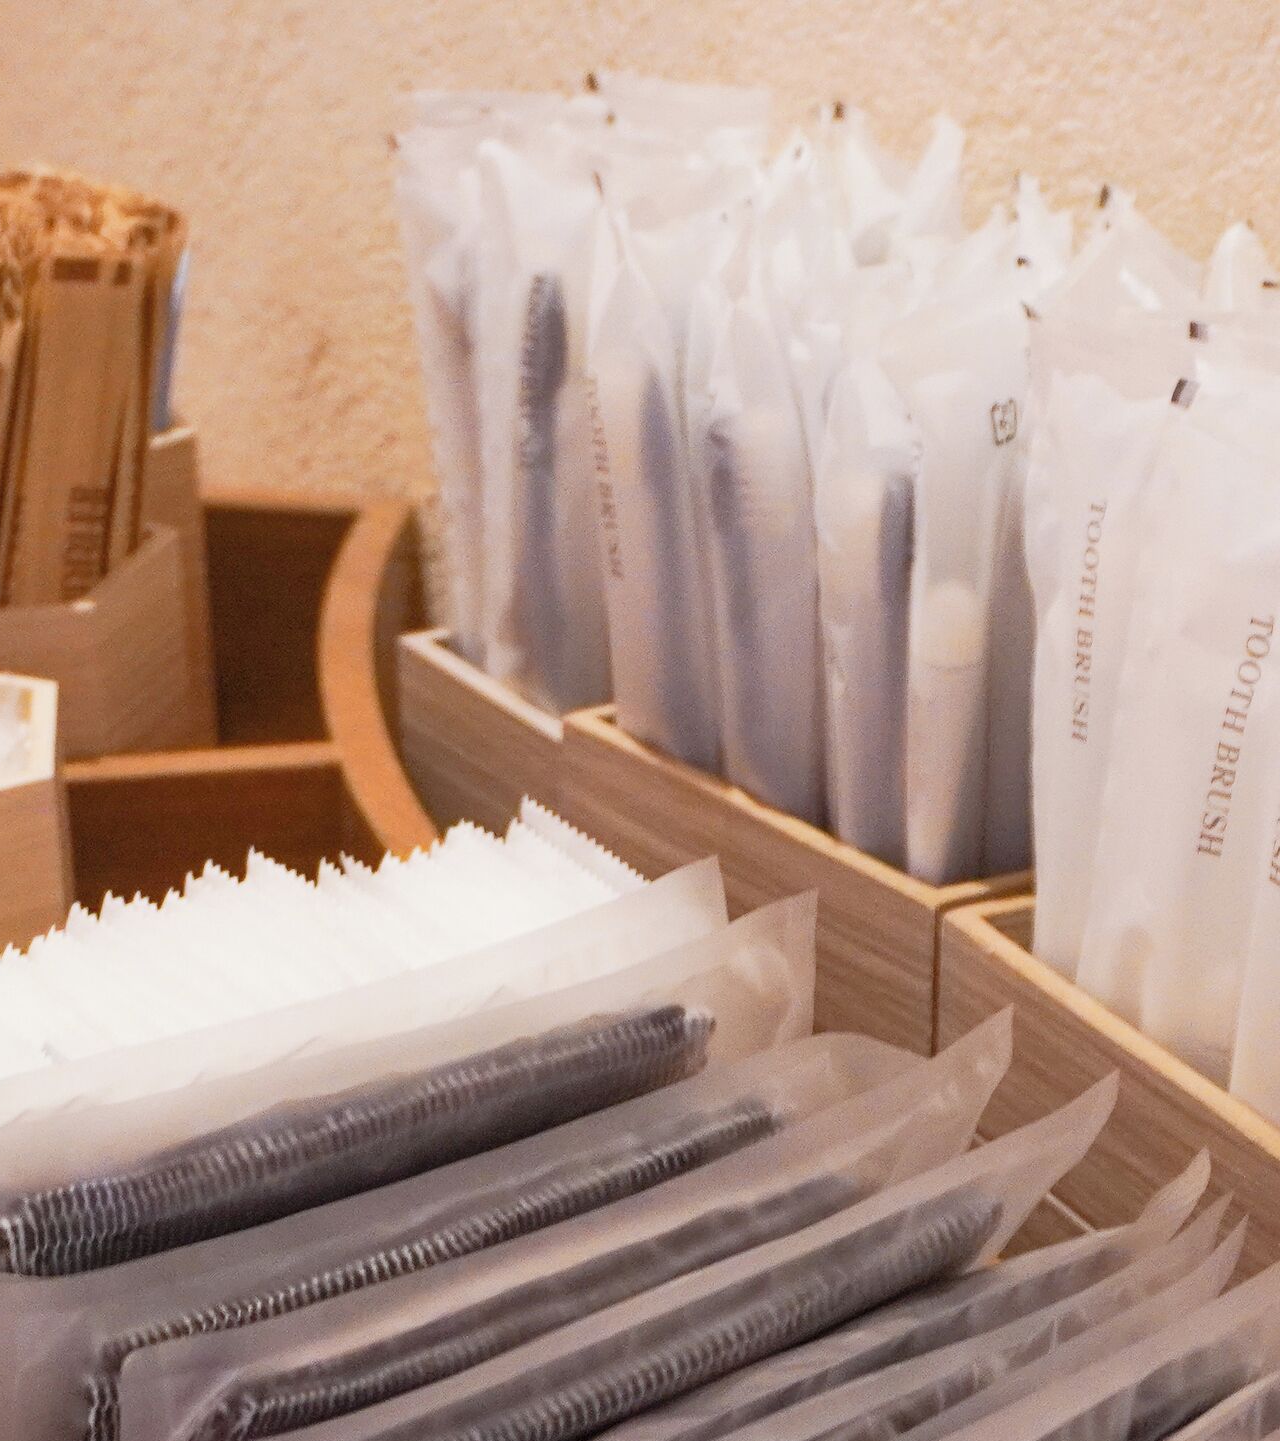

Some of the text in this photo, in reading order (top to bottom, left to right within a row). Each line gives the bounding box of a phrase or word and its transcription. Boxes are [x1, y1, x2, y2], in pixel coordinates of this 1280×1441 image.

[1071, 500, 1108, 742] TOOTH BRUSH
[1197, 615, 1275, 857] TOOTH BRUSH
